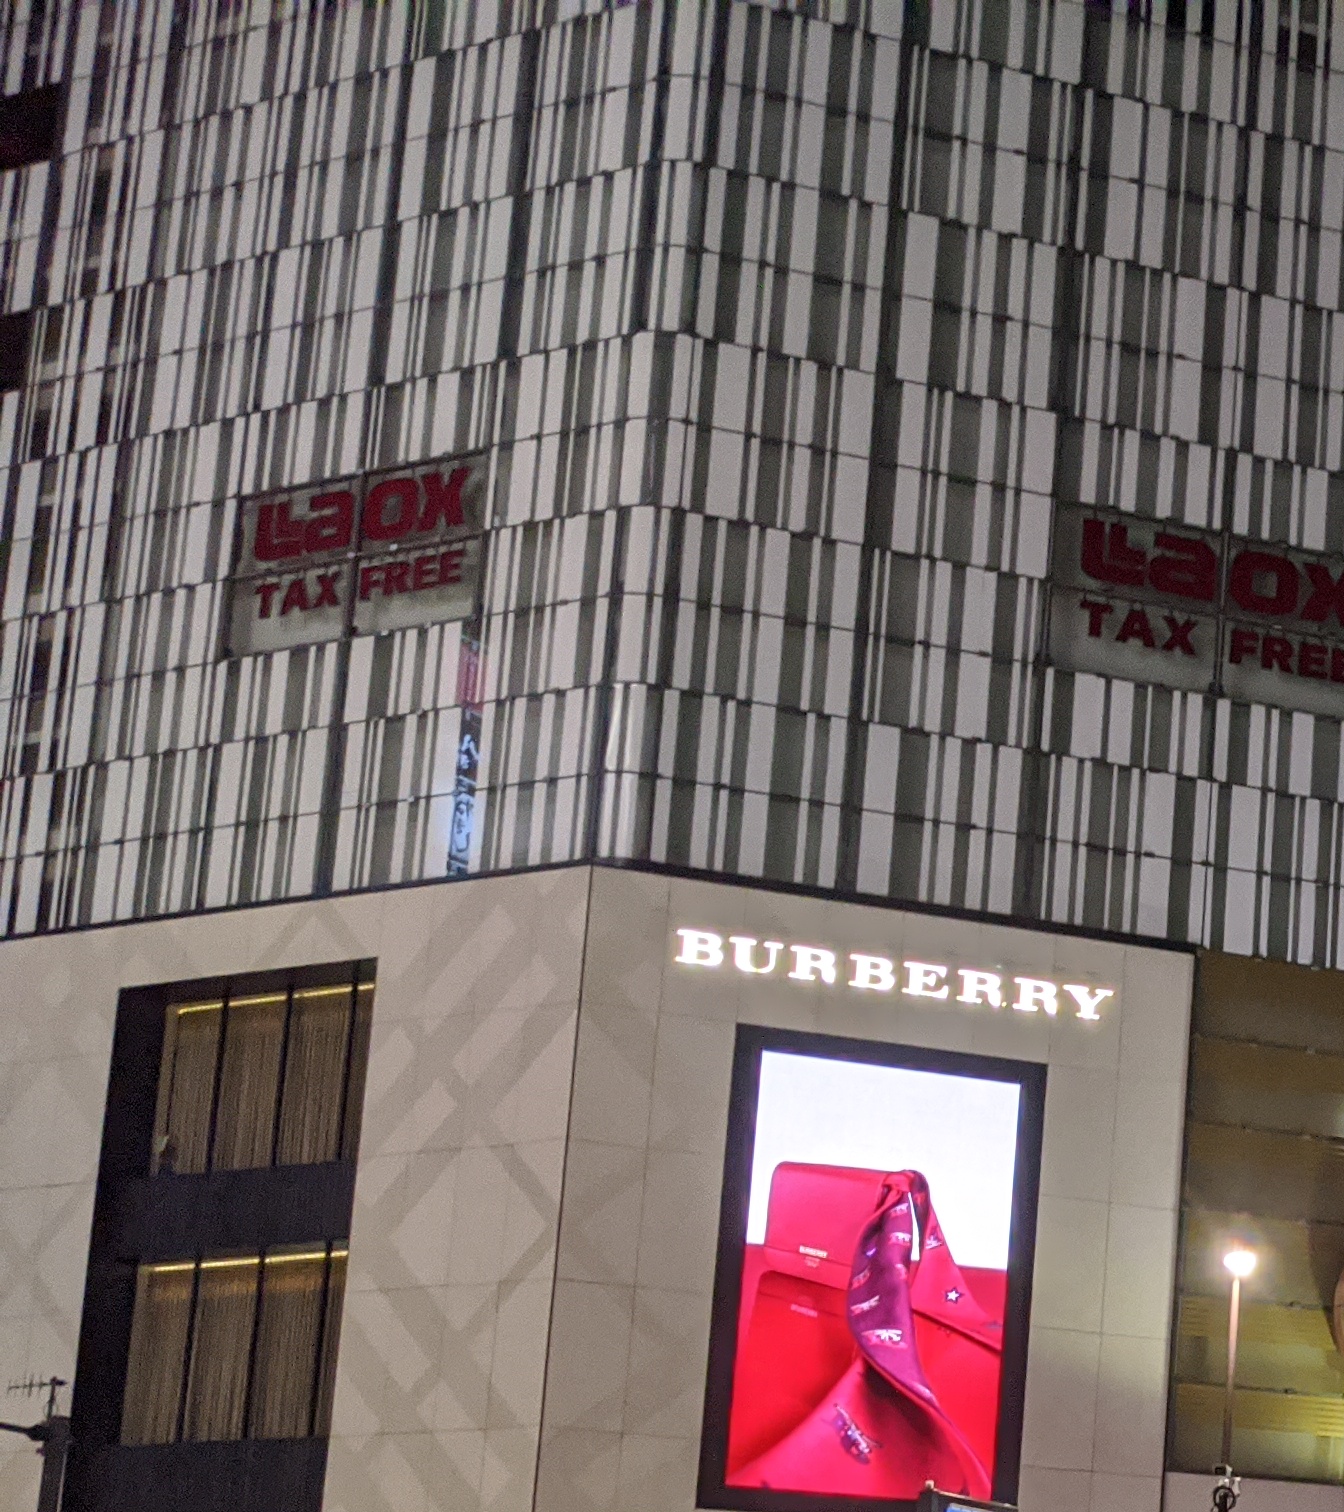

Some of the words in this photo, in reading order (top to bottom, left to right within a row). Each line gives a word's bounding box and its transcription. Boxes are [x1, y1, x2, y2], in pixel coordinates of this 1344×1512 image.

[253, 571, 344, 620] TAX
[359, 550, 467, 600] FREE
[1079, 600, 1198, 656] TAX
[674, 928, 1114, 1021] BURBERRY
